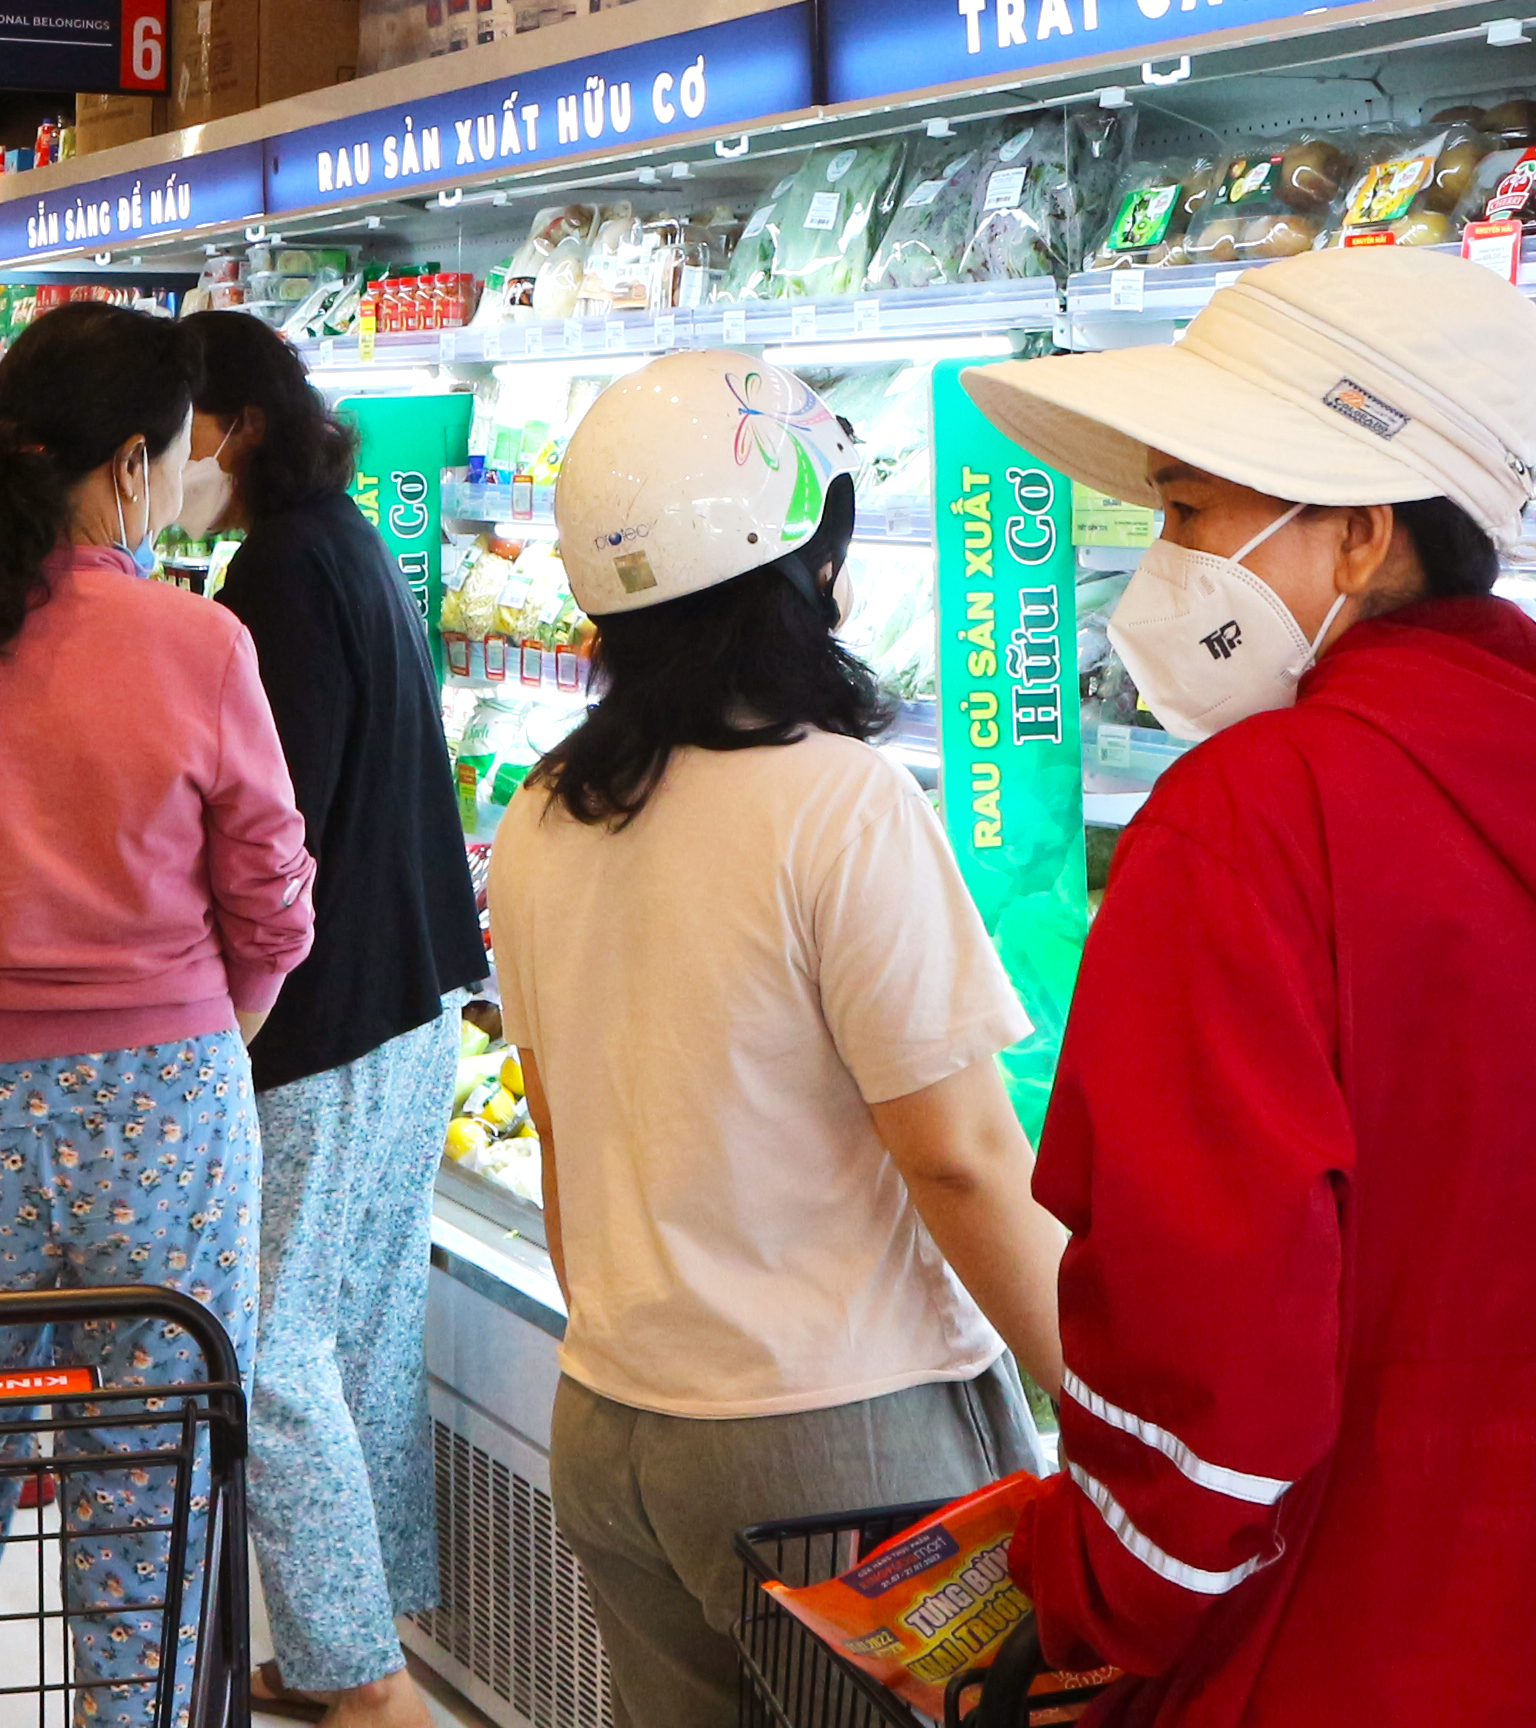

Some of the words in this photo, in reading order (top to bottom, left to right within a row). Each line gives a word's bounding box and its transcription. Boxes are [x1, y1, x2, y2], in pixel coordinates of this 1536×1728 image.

[33, 16, 110, 31] BELONGINGS
[133, 16, 162, 80] 6
[316, 141, 371, 193] RAU
[382, 115, 441, 180] SẢN
[454, 90, 539, 166] XUẤT
[557, 75, 632, 145] HỮU
[652, 54, 707, 124] CƠ
[65, 197, 112, 243] SÀNG
[150, 172, 191, 227] NẤU
[1489, 194, 1528, 212] CHERRY
[947, 465, 995, 579] XUẤT
[1005, 466, 1057, 566] Cơ
[961, 590, 998, 678] SẢN
[1005, 584, 1063, 746] Hữu
[958, 690, 1002, 754] CỦ
[972, 764, 1004, 850] RAU
[959, 1536, 1014, 1596] BỪN
